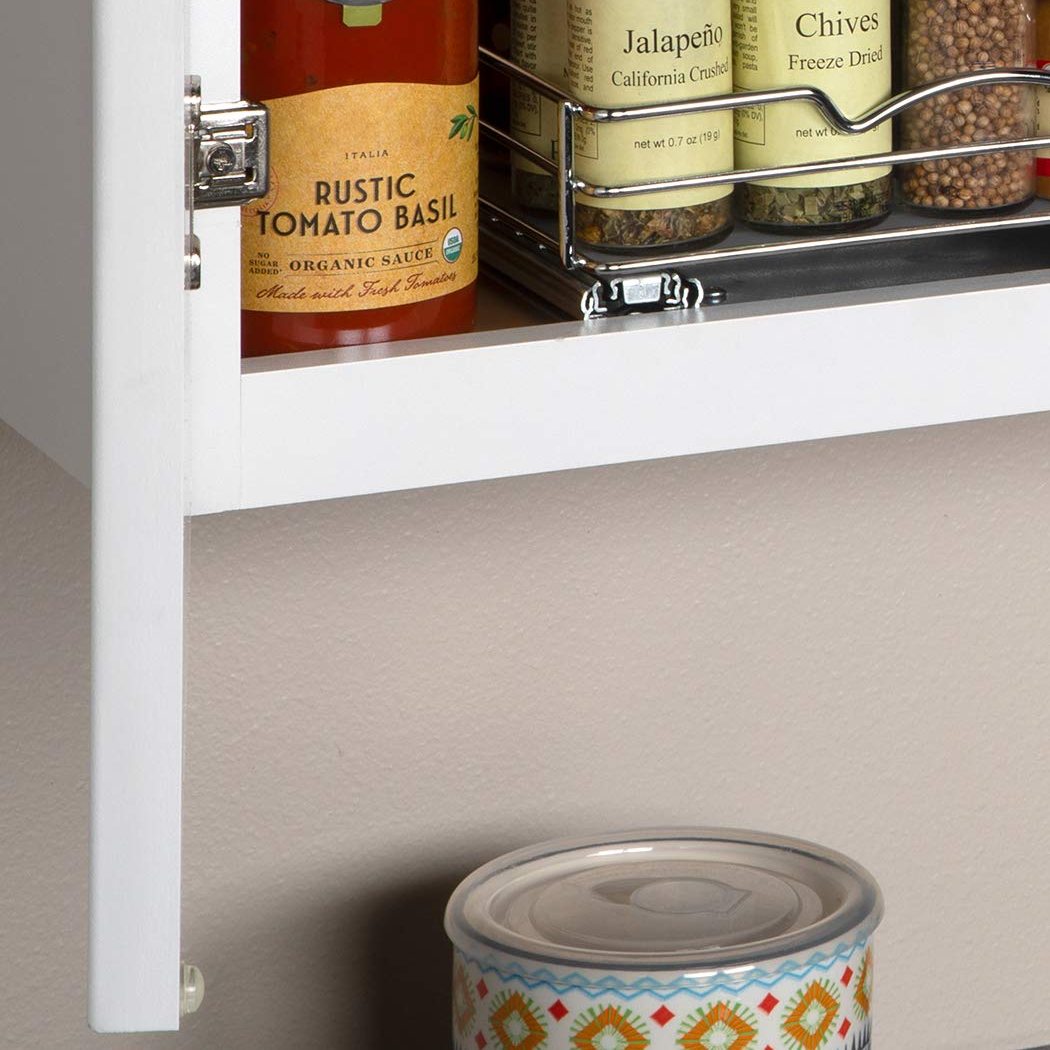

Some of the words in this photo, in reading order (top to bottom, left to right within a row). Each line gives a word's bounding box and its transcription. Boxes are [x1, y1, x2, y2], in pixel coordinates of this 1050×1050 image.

[795, 11, 879, 39] Chives
[623, 23, 724, 59] Jalapeño
[788, 54, 844, 71] Freeze
[848, 46, 883, 69] Dried
[611, 68, 686, 88] California
[689, 59, 729, 83] Crushed
[345, 150, 389, 160] ITALIA
[634, 139, 651, 149] net
[653, 138, 665, 149] wt
[668, 136, 683, 148] 0.7
[686, 136, 697, 145] oz
[315, 173, 416, 206] RUSTIC
[256, 208, 382, 237] TOMATO
[395, 193, 457, 230] BASIL
[249, 259, 279, 268] SUGAR
[289, 256, 376, 272] ORGANIC
[381, 247, 433, 266] SAUCE
[256, 283, 307, 300] Made
[312, 282, 352, 299] with
[357, 280, 402, 298] Fresh
[404, 271, 457, 292] Tomatoes
